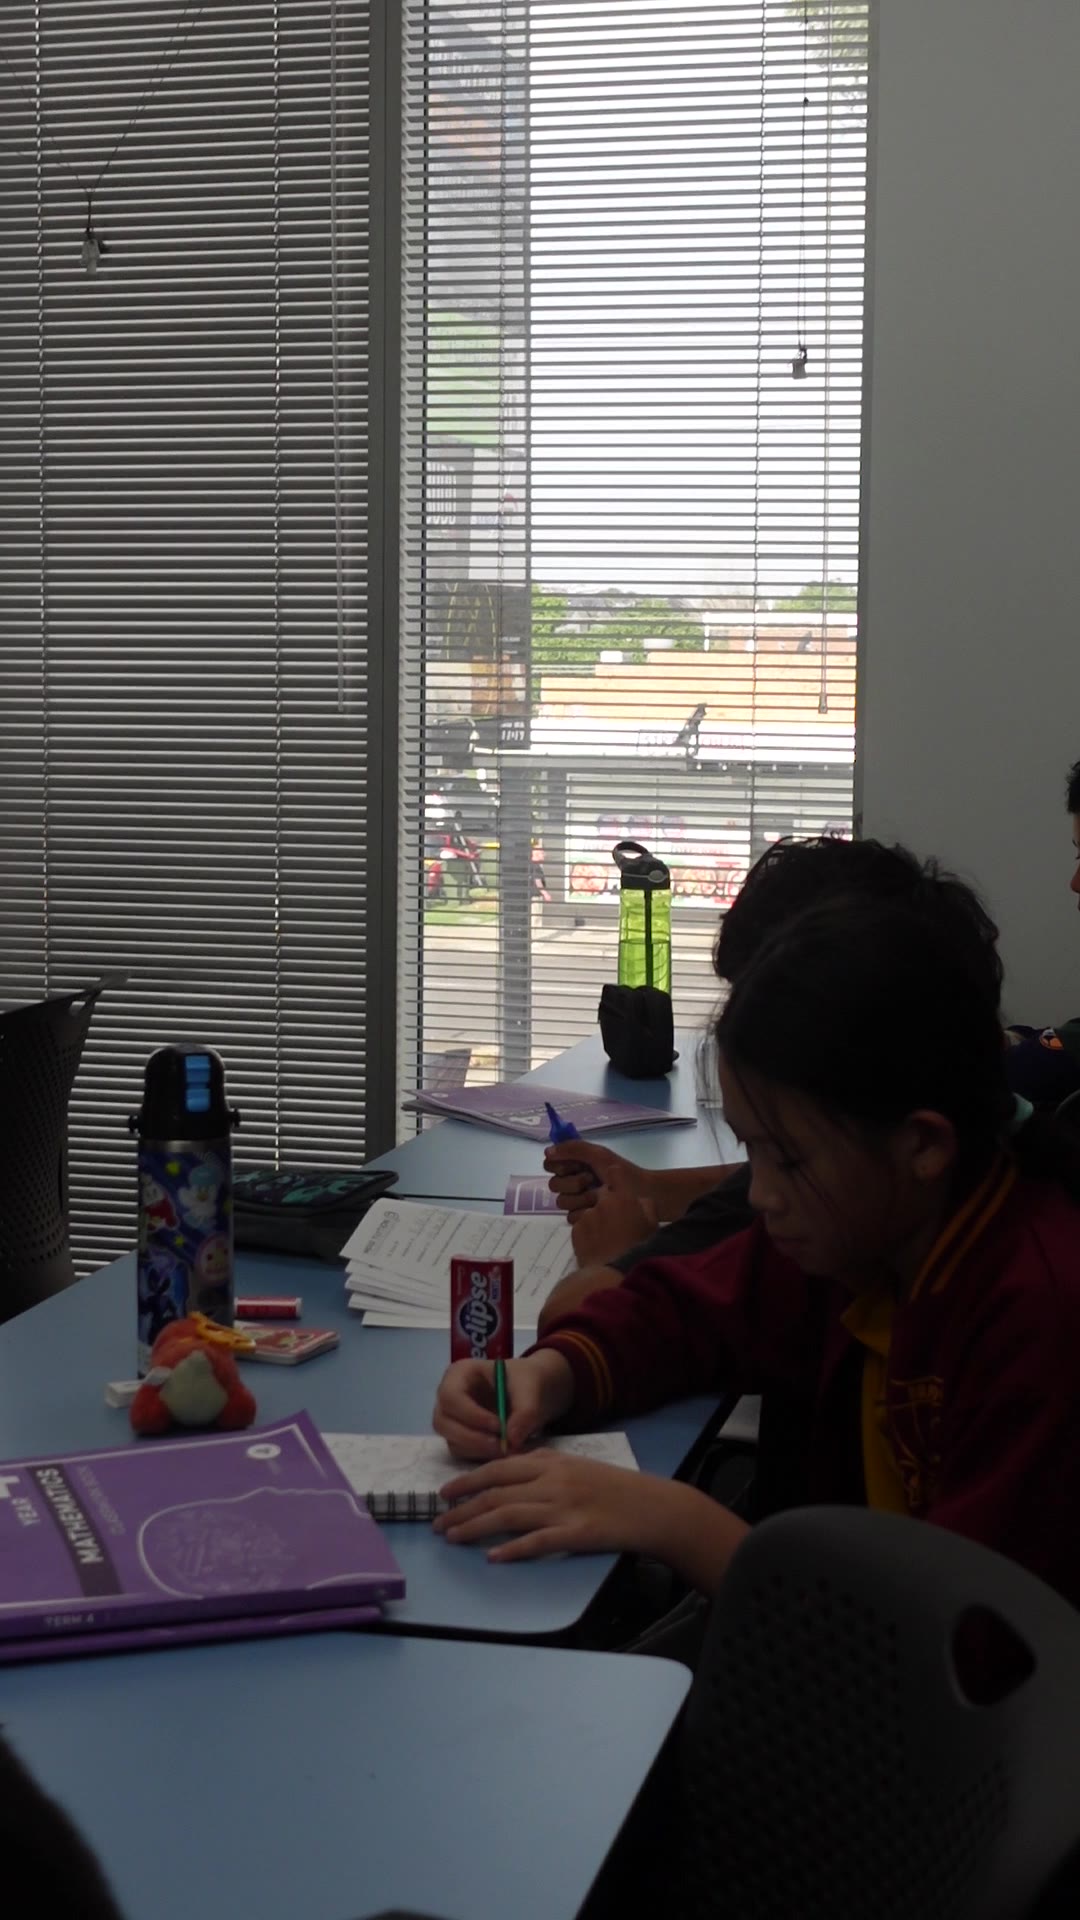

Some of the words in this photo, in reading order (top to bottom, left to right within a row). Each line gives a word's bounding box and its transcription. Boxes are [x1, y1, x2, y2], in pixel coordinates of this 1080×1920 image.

[465, 1271, 494, 1360] eclipse
[11, 1497, 40, 1527] YEAR
[36, 1467, 104, 1564] MATHEMATICS
[45, 1615, 82, 1629] TERM
